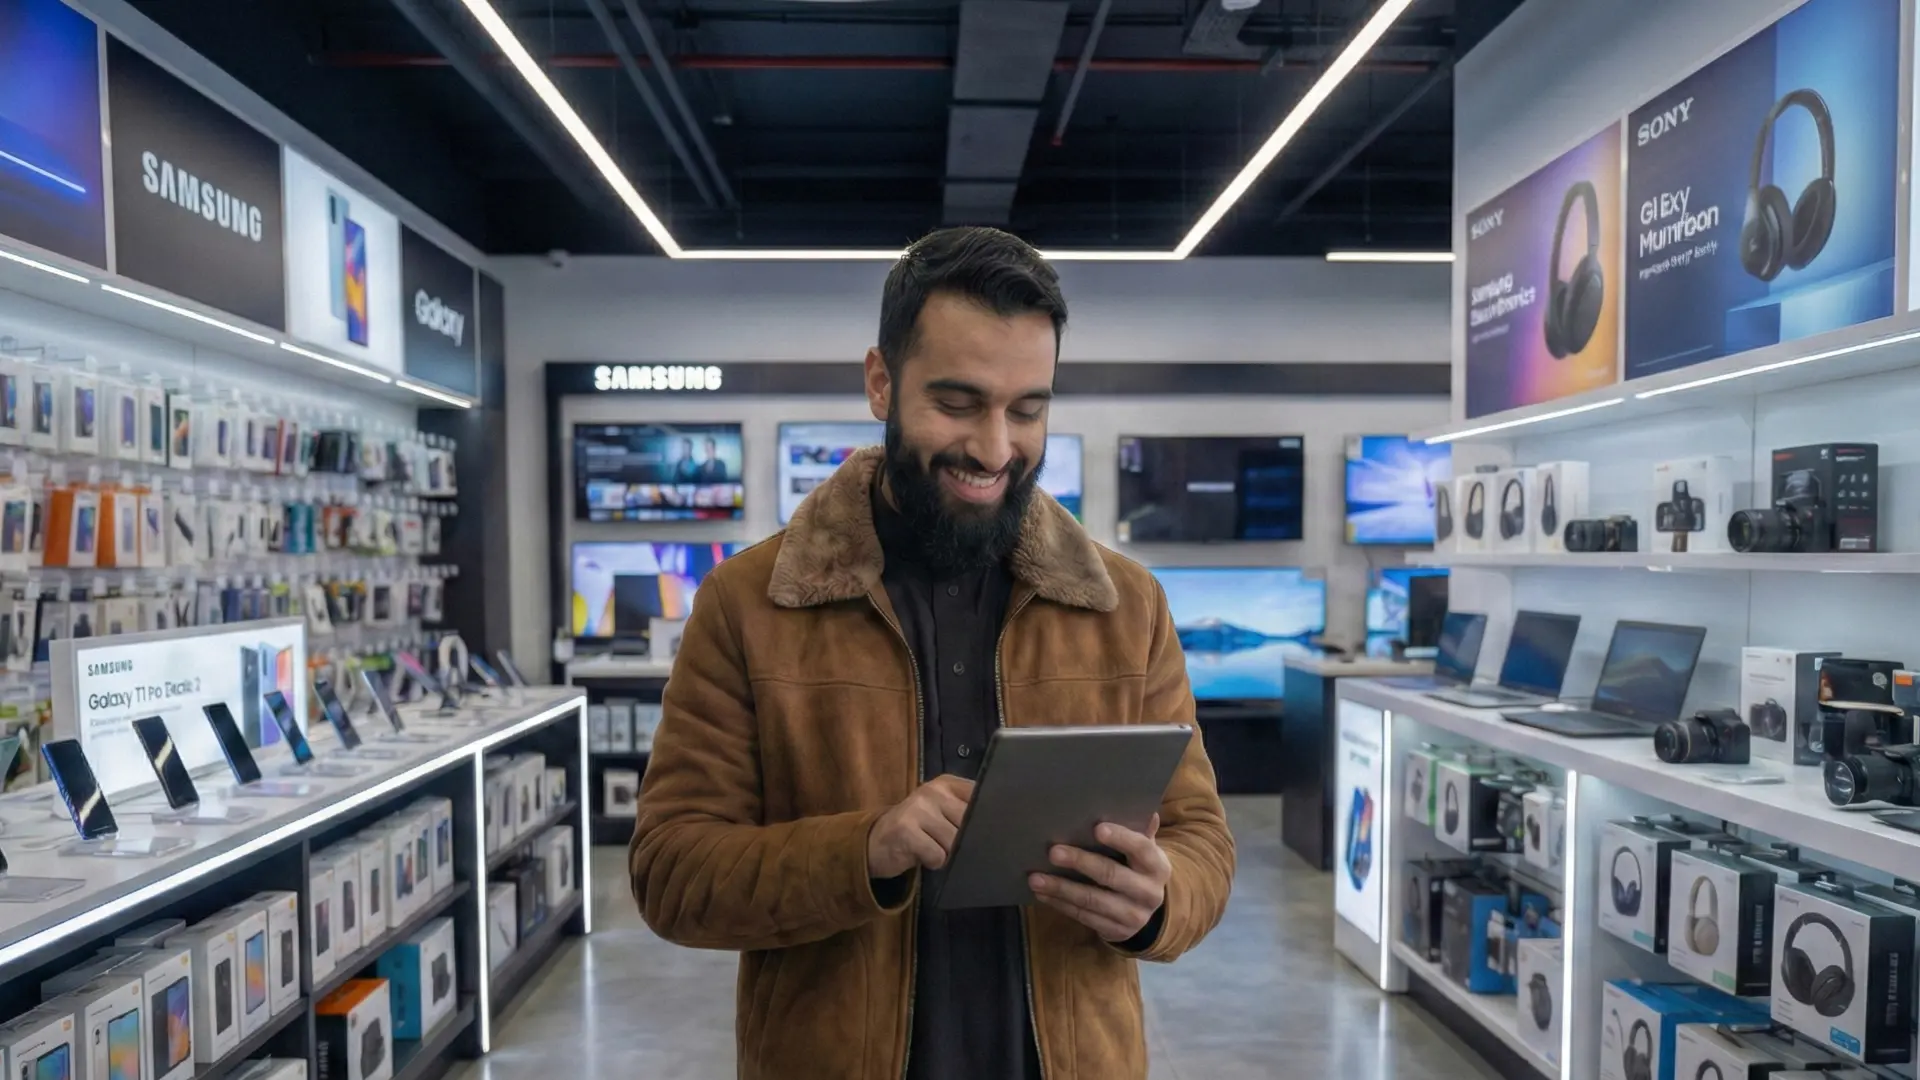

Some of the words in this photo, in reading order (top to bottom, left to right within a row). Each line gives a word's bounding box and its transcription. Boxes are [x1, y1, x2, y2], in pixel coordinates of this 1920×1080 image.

[1637, 96, 1695, 147] SONY
[142, 150, 262, 242] SAMSUNG
[594, 365, 722, 391] SAMSUNG
[88, 659, 133, 676] SAMSUNG
[88, 691, 133, 710] Galaxy
